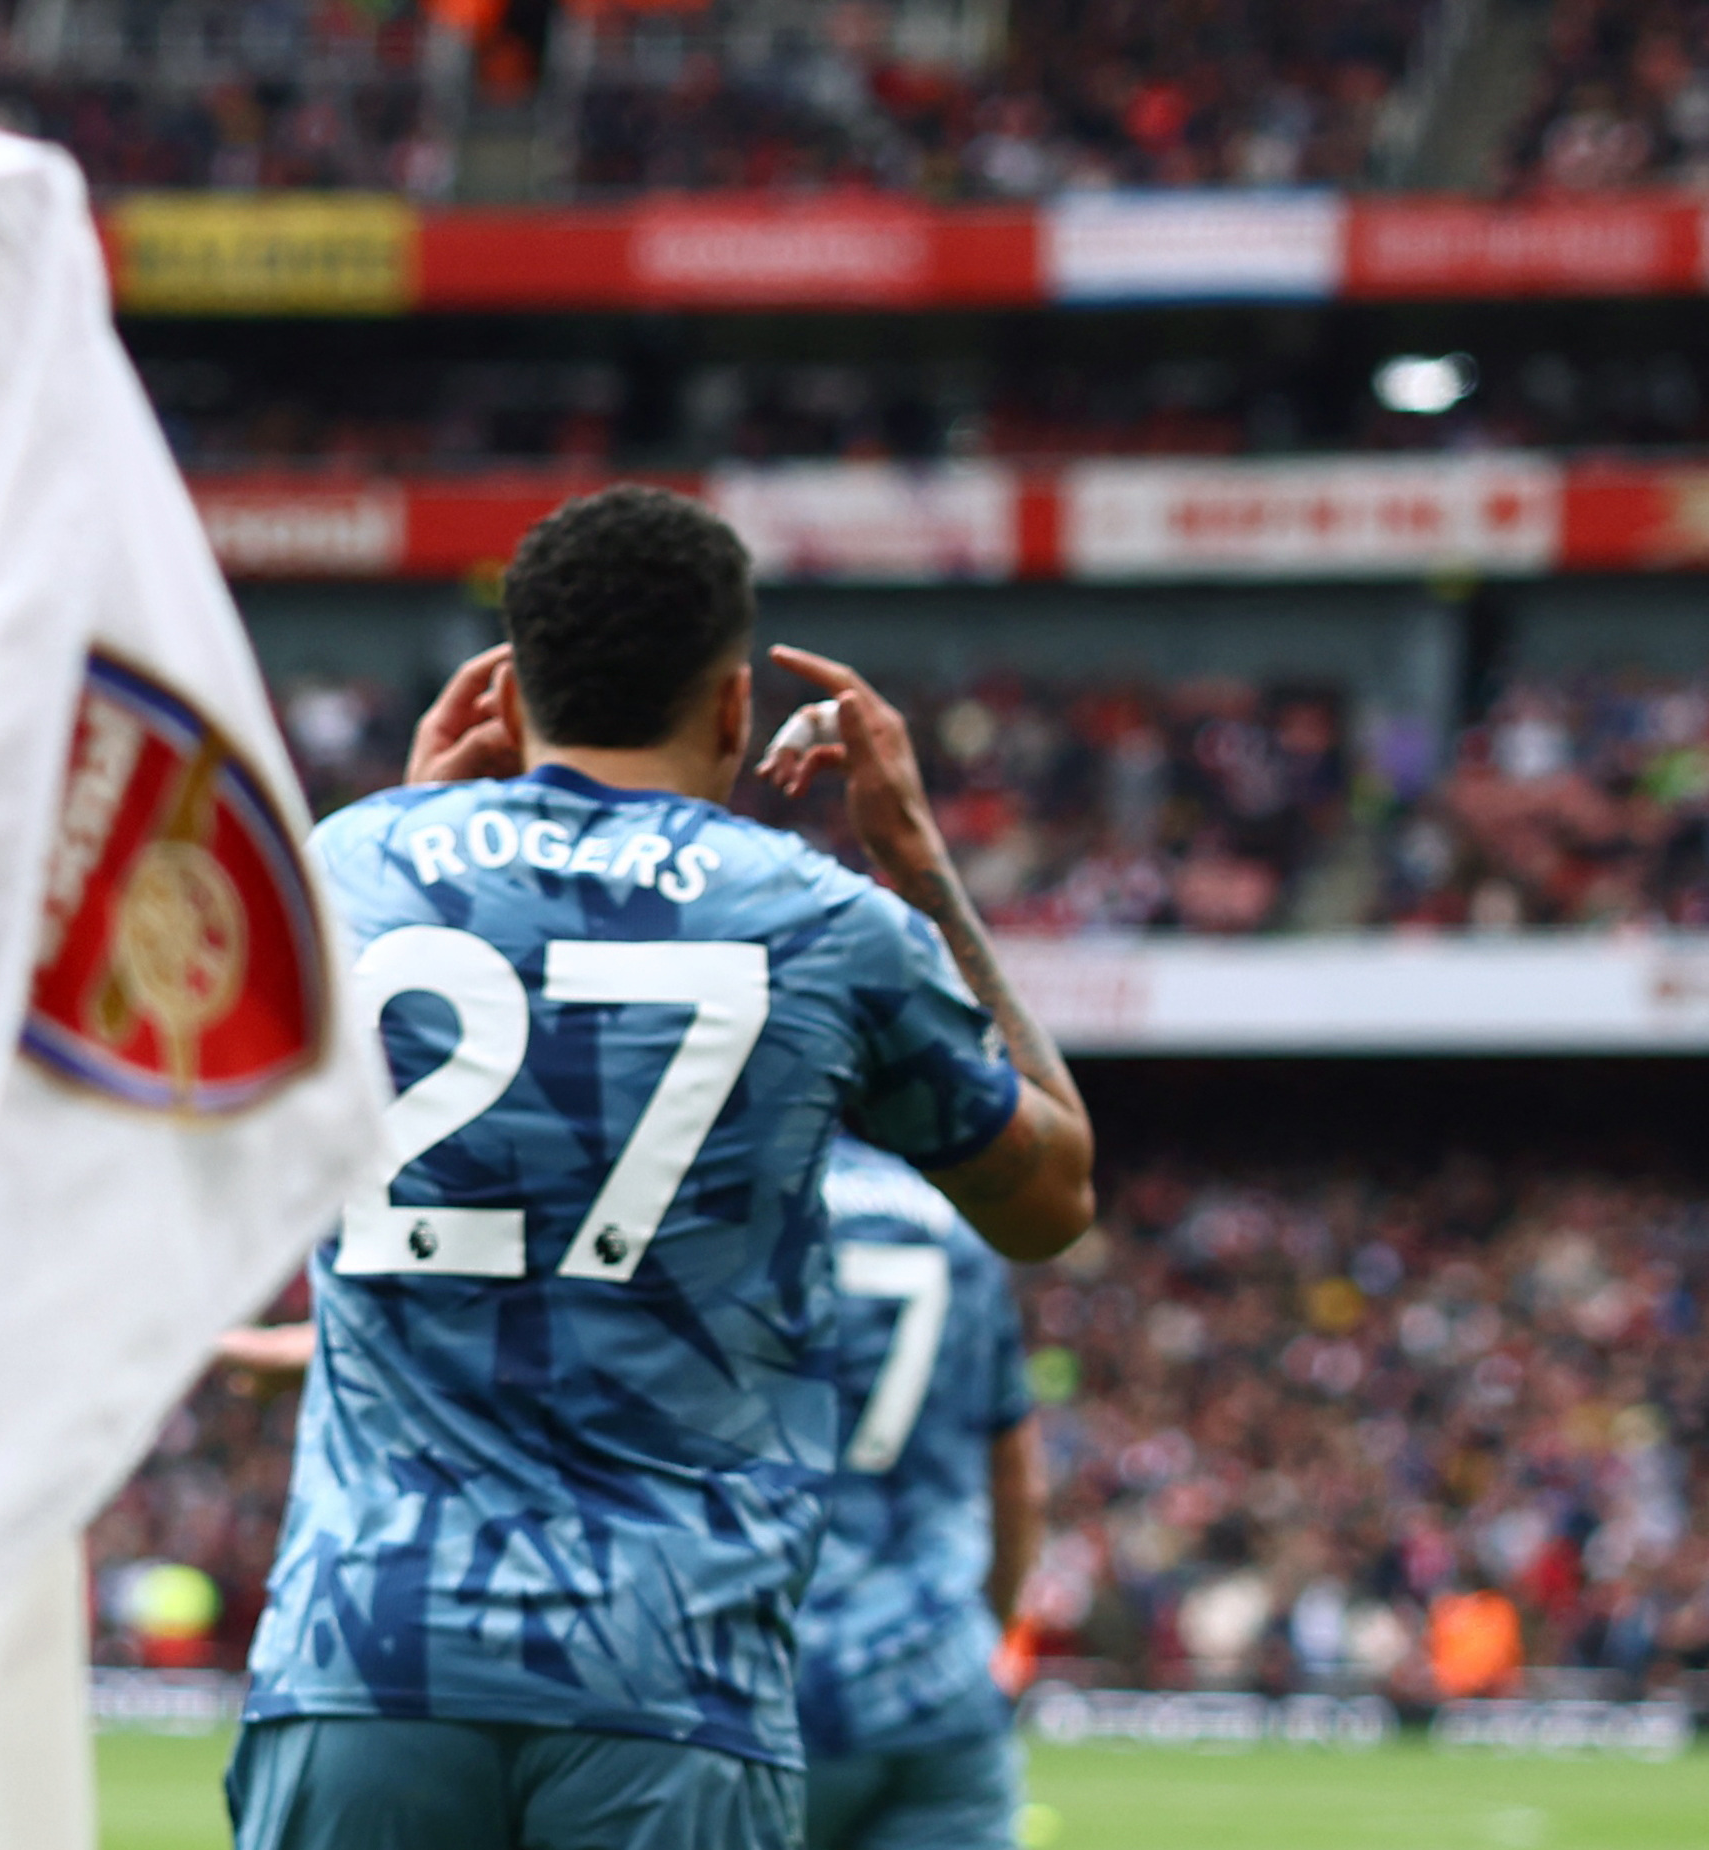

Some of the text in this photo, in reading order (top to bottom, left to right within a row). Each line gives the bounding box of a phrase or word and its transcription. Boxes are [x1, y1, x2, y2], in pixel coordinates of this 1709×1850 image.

[409, 809, 722, 904] ROGERS
[334, 923, 770, 1282] 27
[835, 1242, 952, 1473] 7
